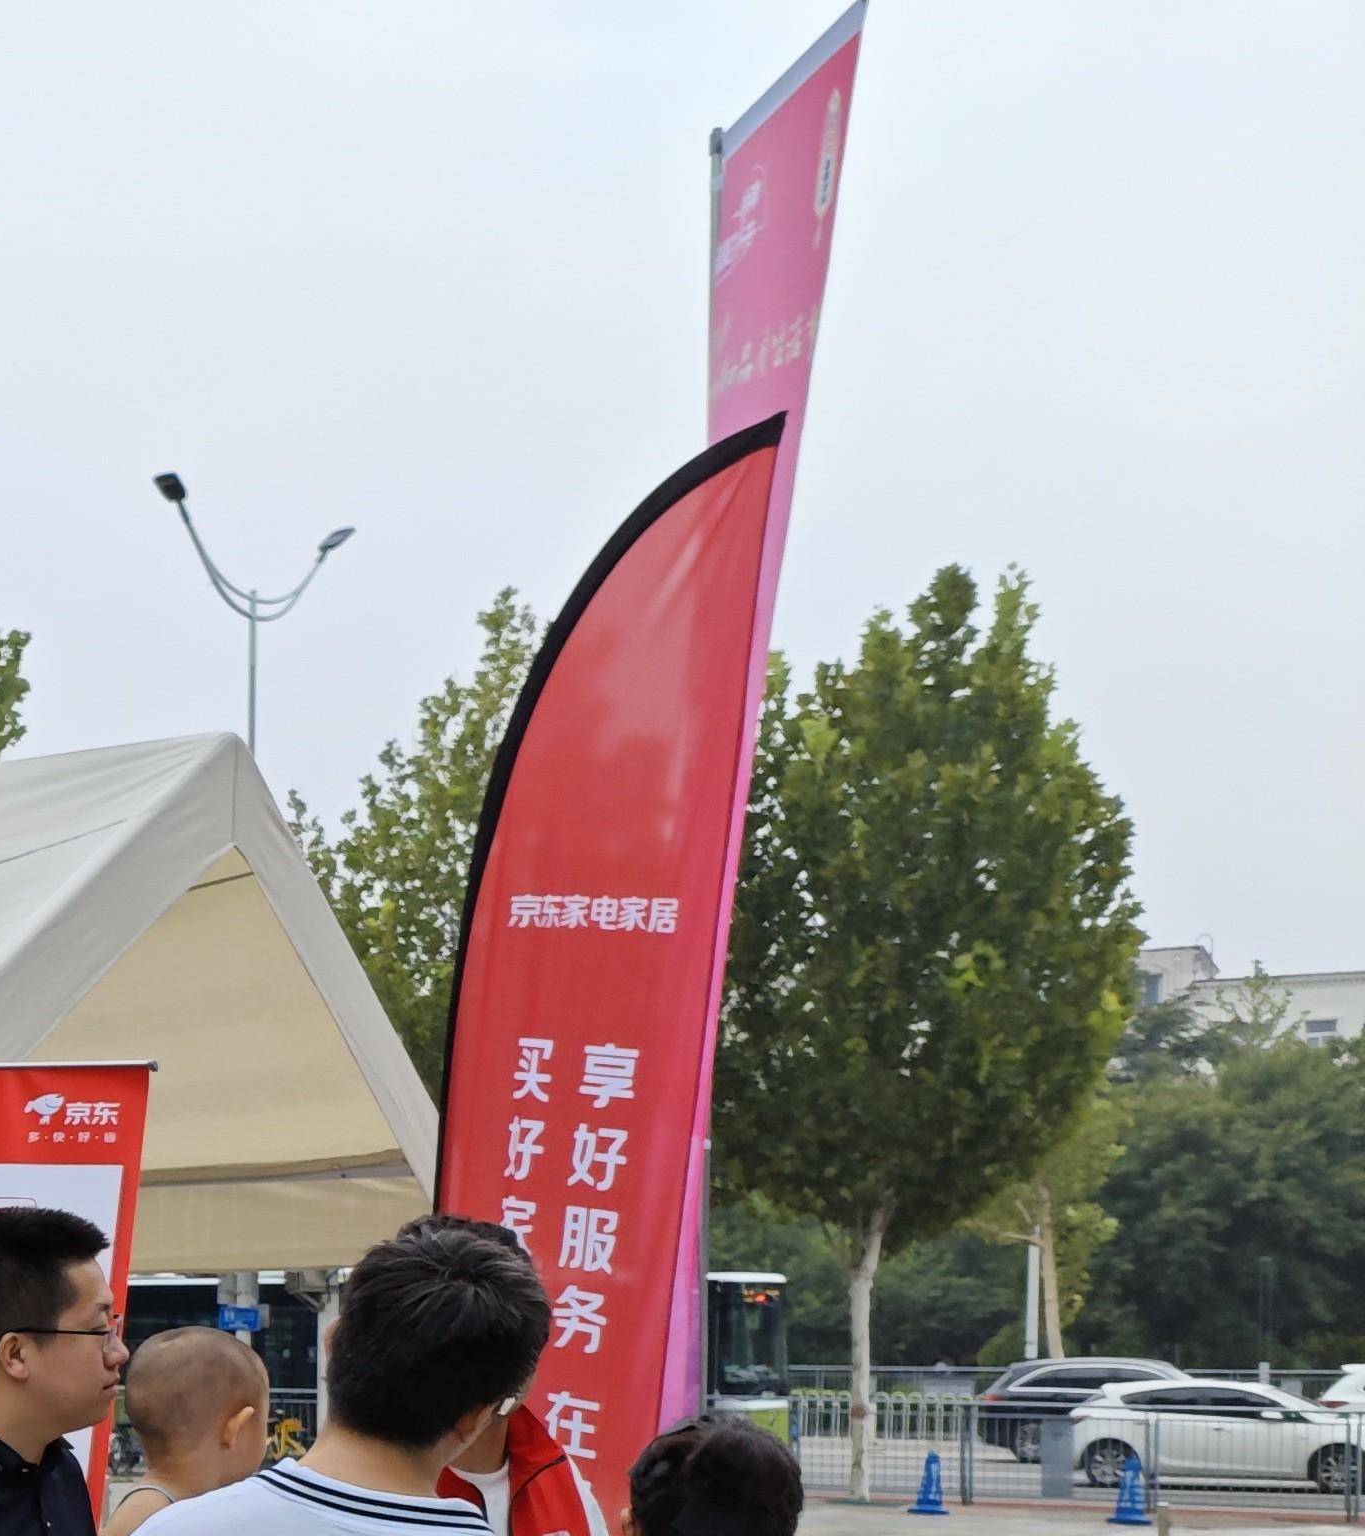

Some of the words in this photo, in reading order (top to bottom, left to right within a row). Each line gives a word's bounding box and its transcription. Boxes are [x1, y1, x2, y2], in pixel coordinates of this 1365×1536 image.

[507, 894, 680, 934] 京东家电家居
[63, 1101, 121, 1126] 京东
